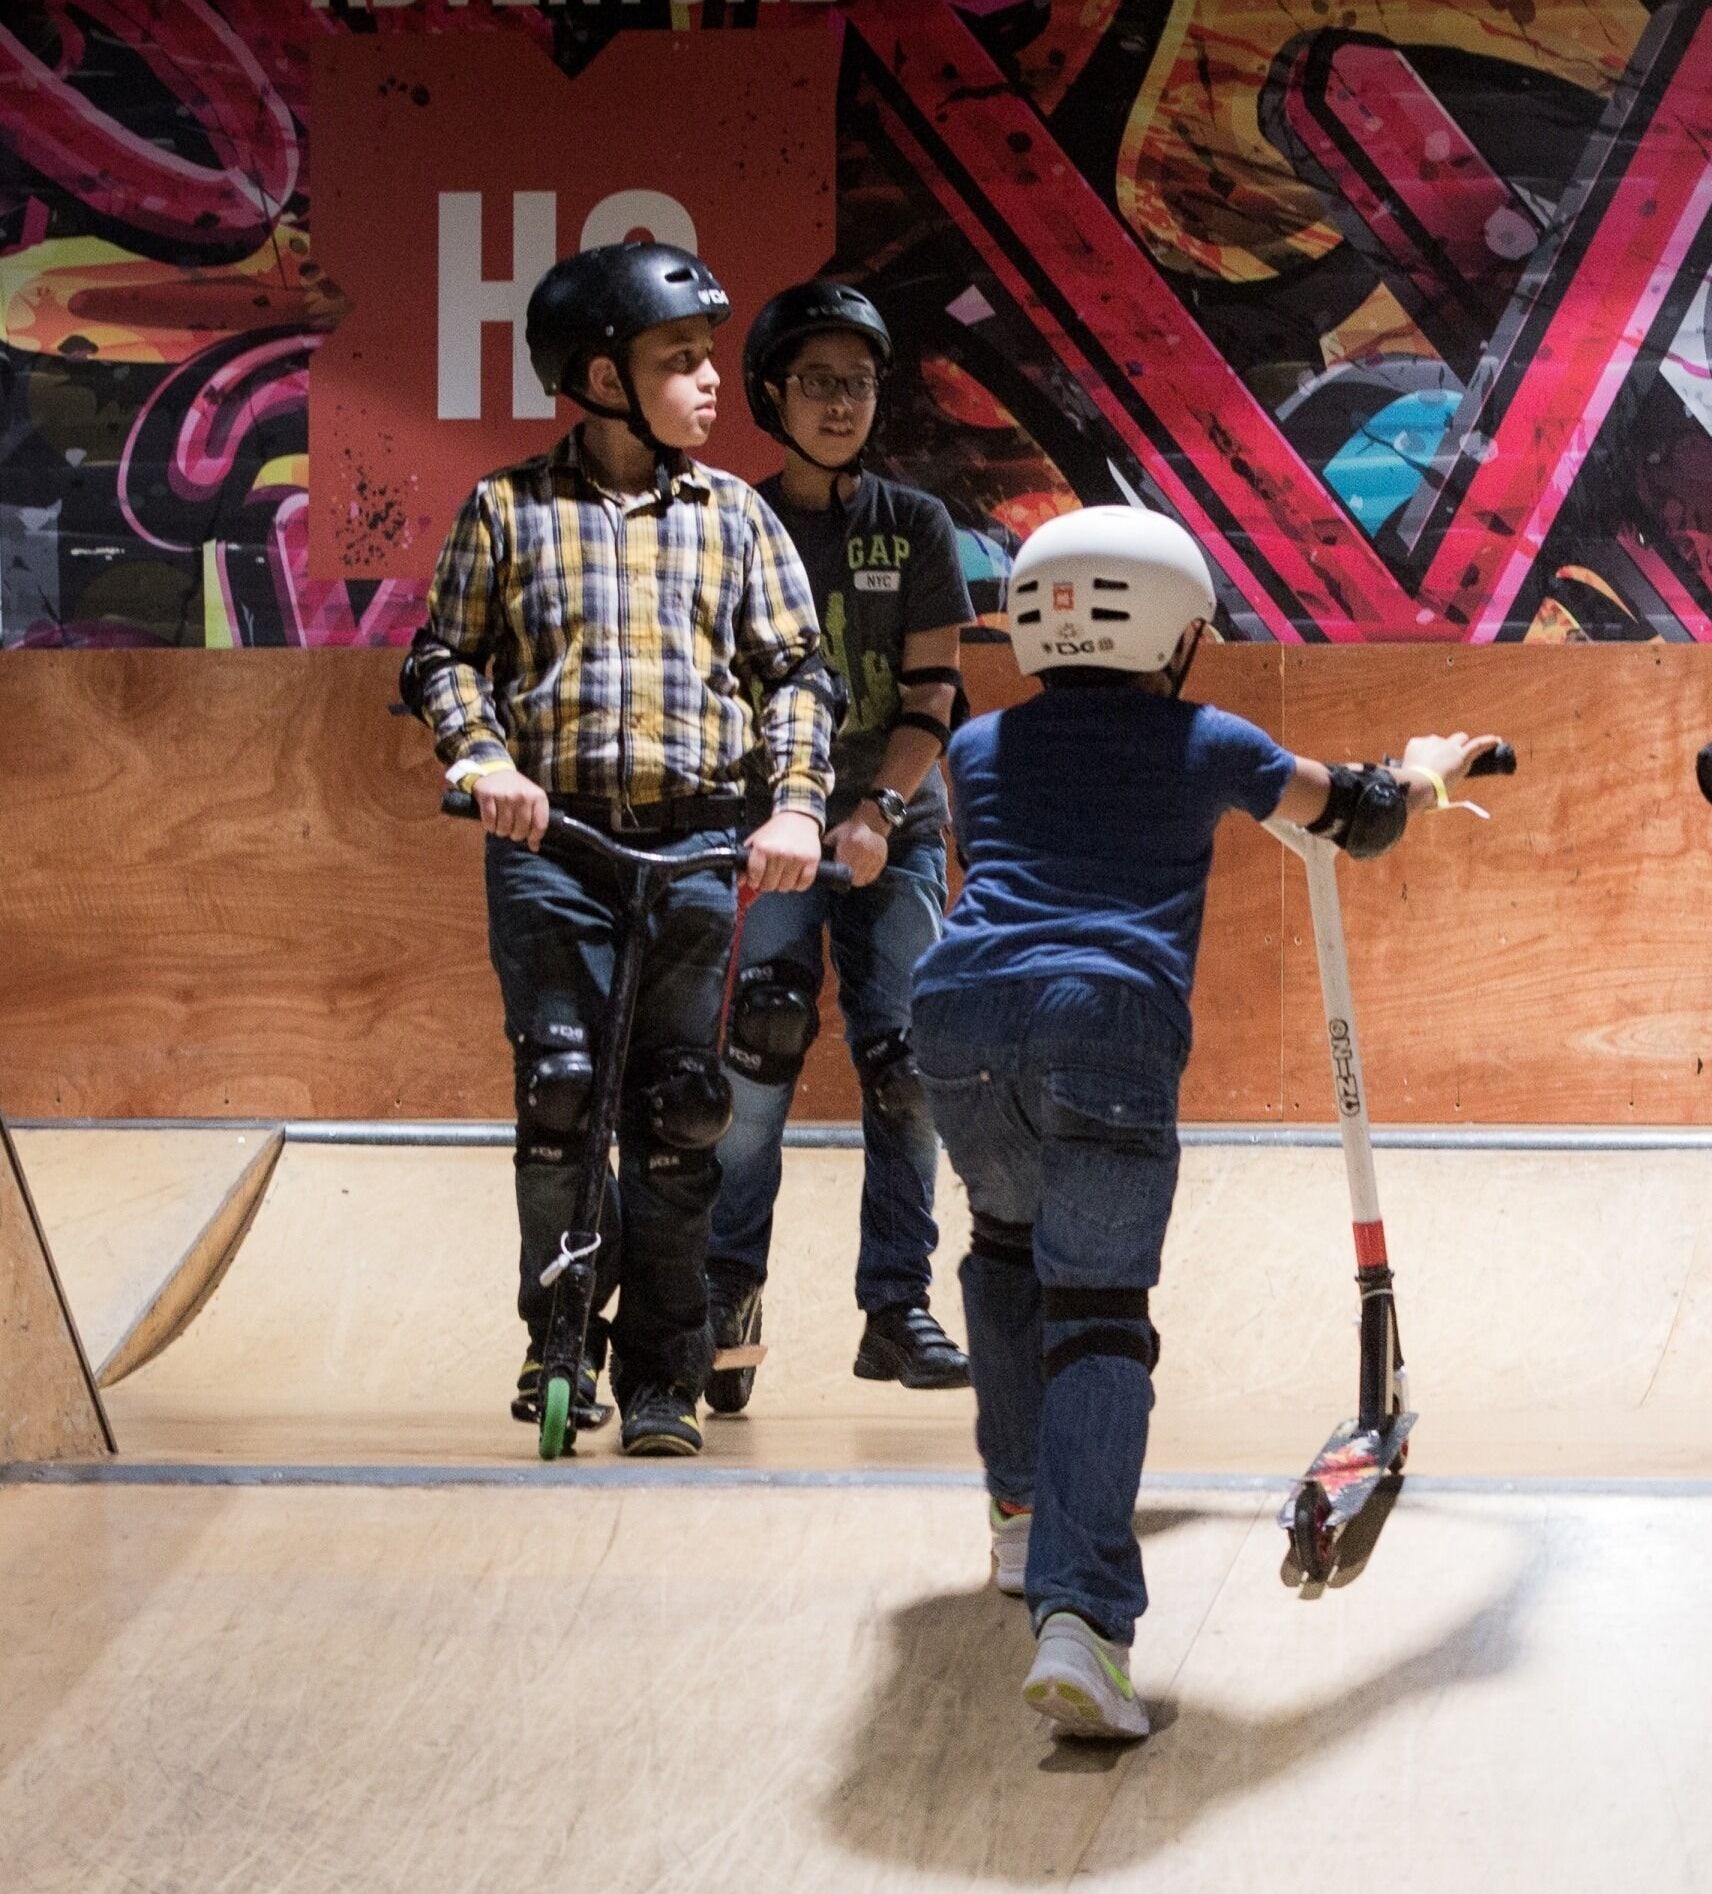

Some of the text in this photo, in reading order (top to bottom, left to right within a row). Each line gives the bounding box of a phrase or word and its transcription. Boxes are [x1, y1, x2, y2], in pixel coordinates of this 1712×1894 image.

[437, 189, 698, 420] H
[847, 534, 911, 570] GAP
[867, 575, 893, 589] NYC
